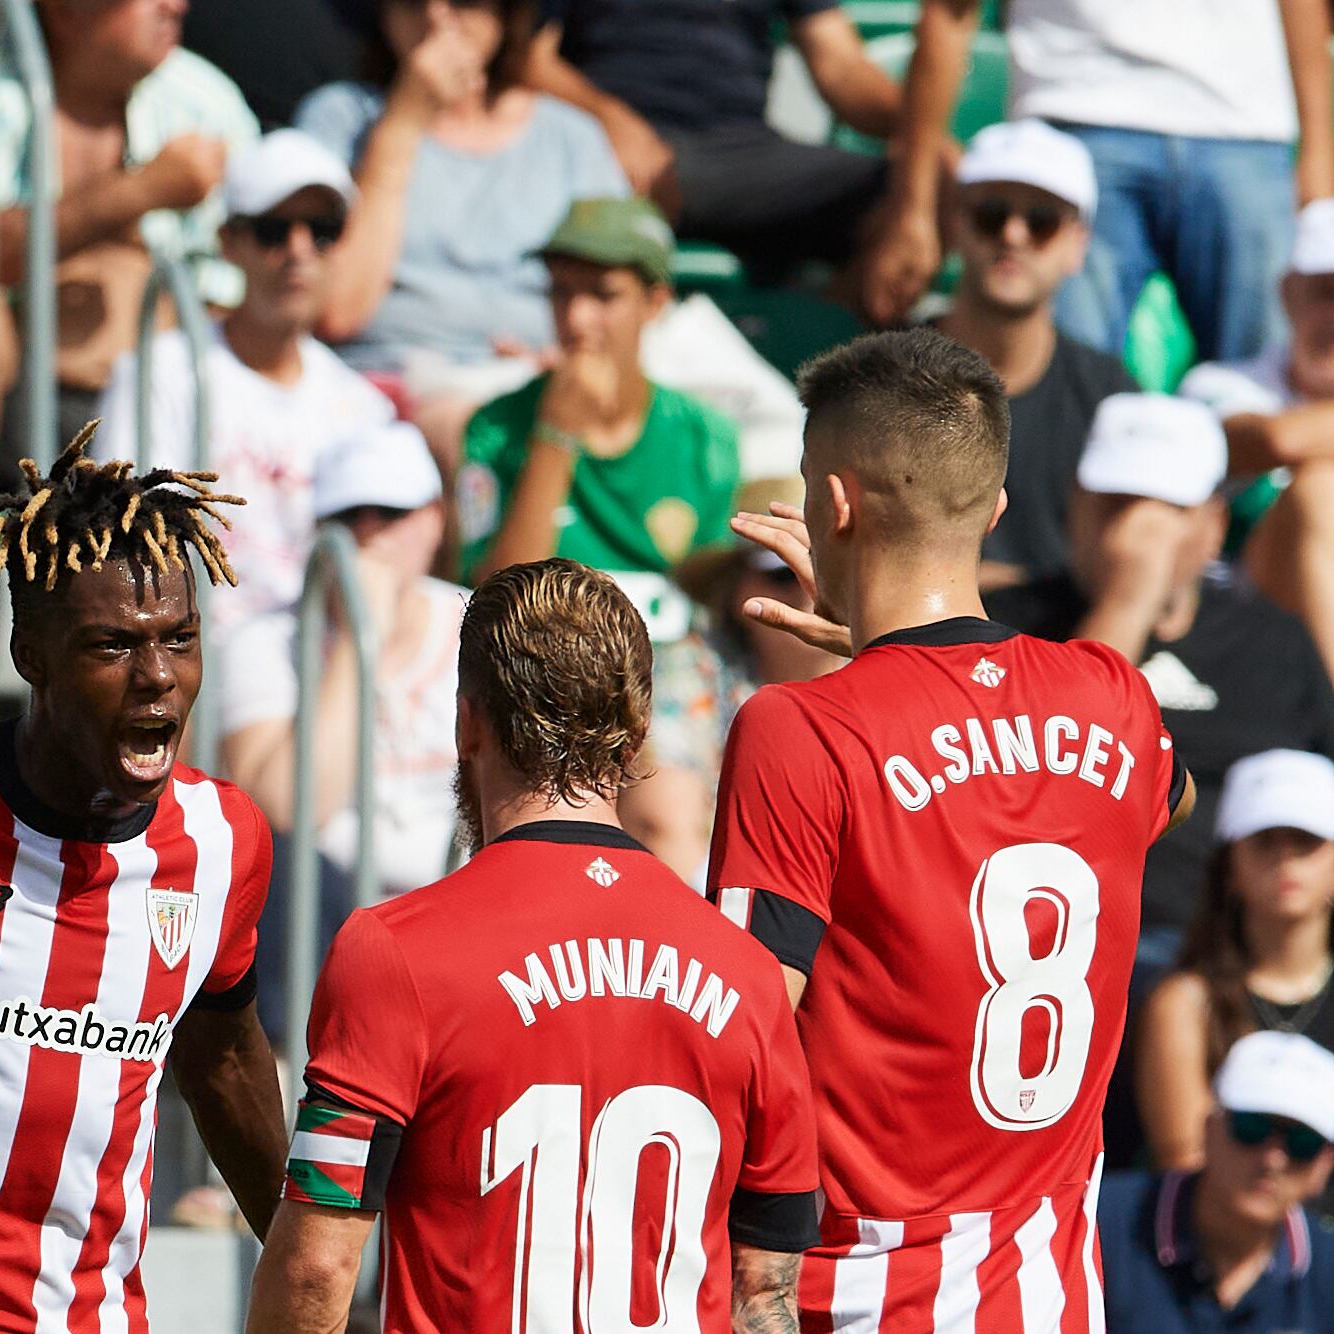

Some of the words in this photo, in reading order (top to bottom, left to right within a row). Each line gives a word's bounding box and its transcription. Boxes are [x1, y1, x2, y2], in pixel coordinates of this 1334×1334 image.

[883, 714, 1135, 812] O.SANCET
[498, 938, 741, 1039] MUNIAIN
[969, 842, 1100, 1132] 8
